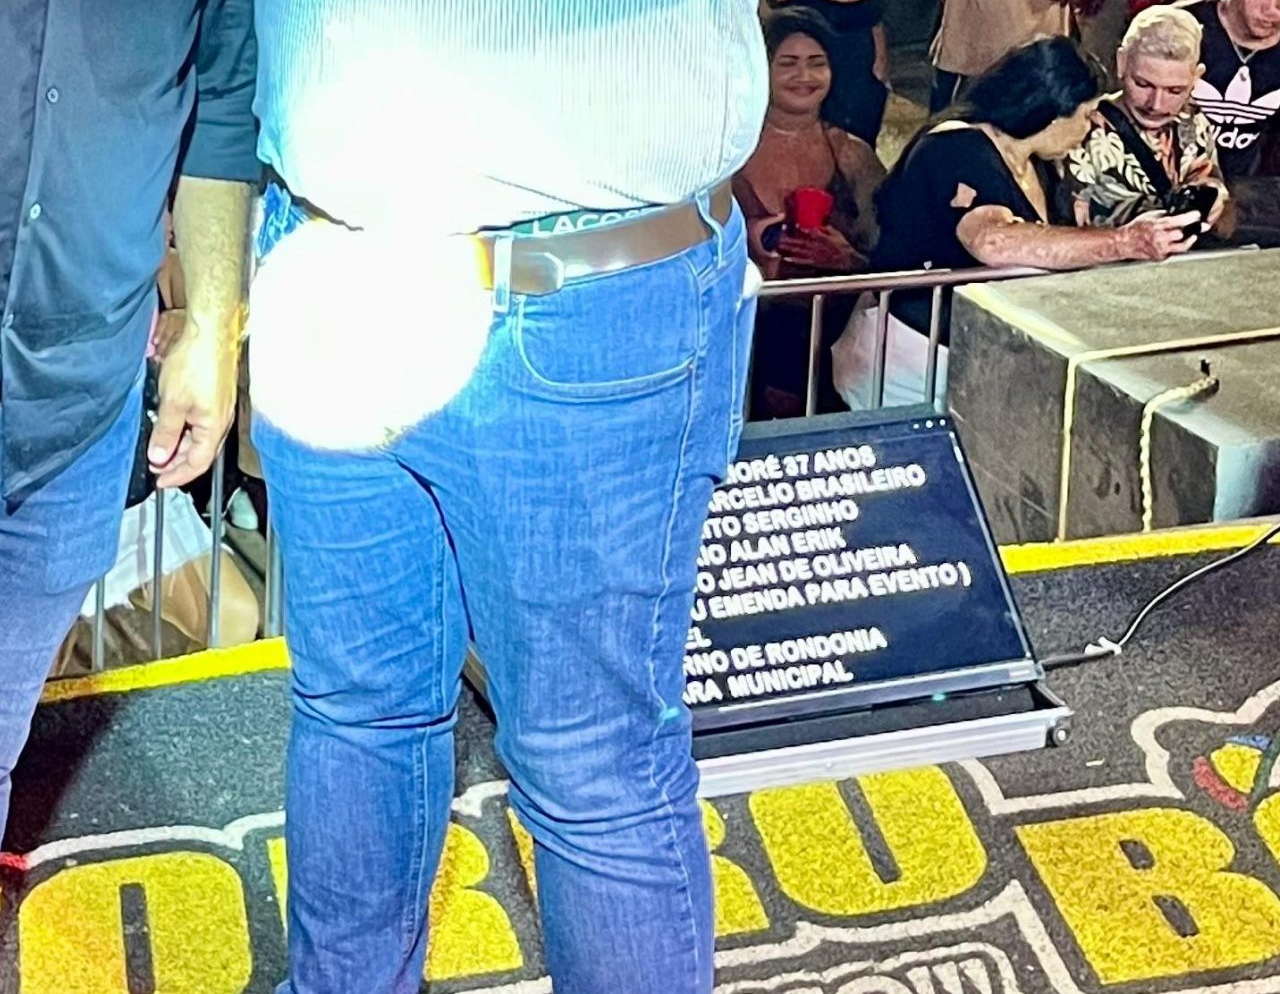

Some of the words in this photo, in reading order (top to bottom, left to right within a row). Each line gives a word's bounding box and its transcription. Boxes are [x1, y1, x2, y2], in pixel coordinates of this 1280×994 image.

[814, 445, 876, 473] ANOS
[795, 463, 926, 501] BRASILEIRO
[742, 499, 859, 534] SERGINHO
[730, 534, 791, 563] ALAN
[791, 526, 847, 554] ERIK
[718, 562, 779, 591] JEAN
[779, 557, 813, 583] DE
[812, 542, 918, 577] OLIVEIRA
[708, 586, 806, 619] EMENDA
[805, 576, 869, 606] PARA
[867, 562, 958, 597] EVENTO
[730, 644, 766, 670] DE
[764, 626, 888, 665] RONDONIA
[727, 659, 854, 698] MUNICIPAL
